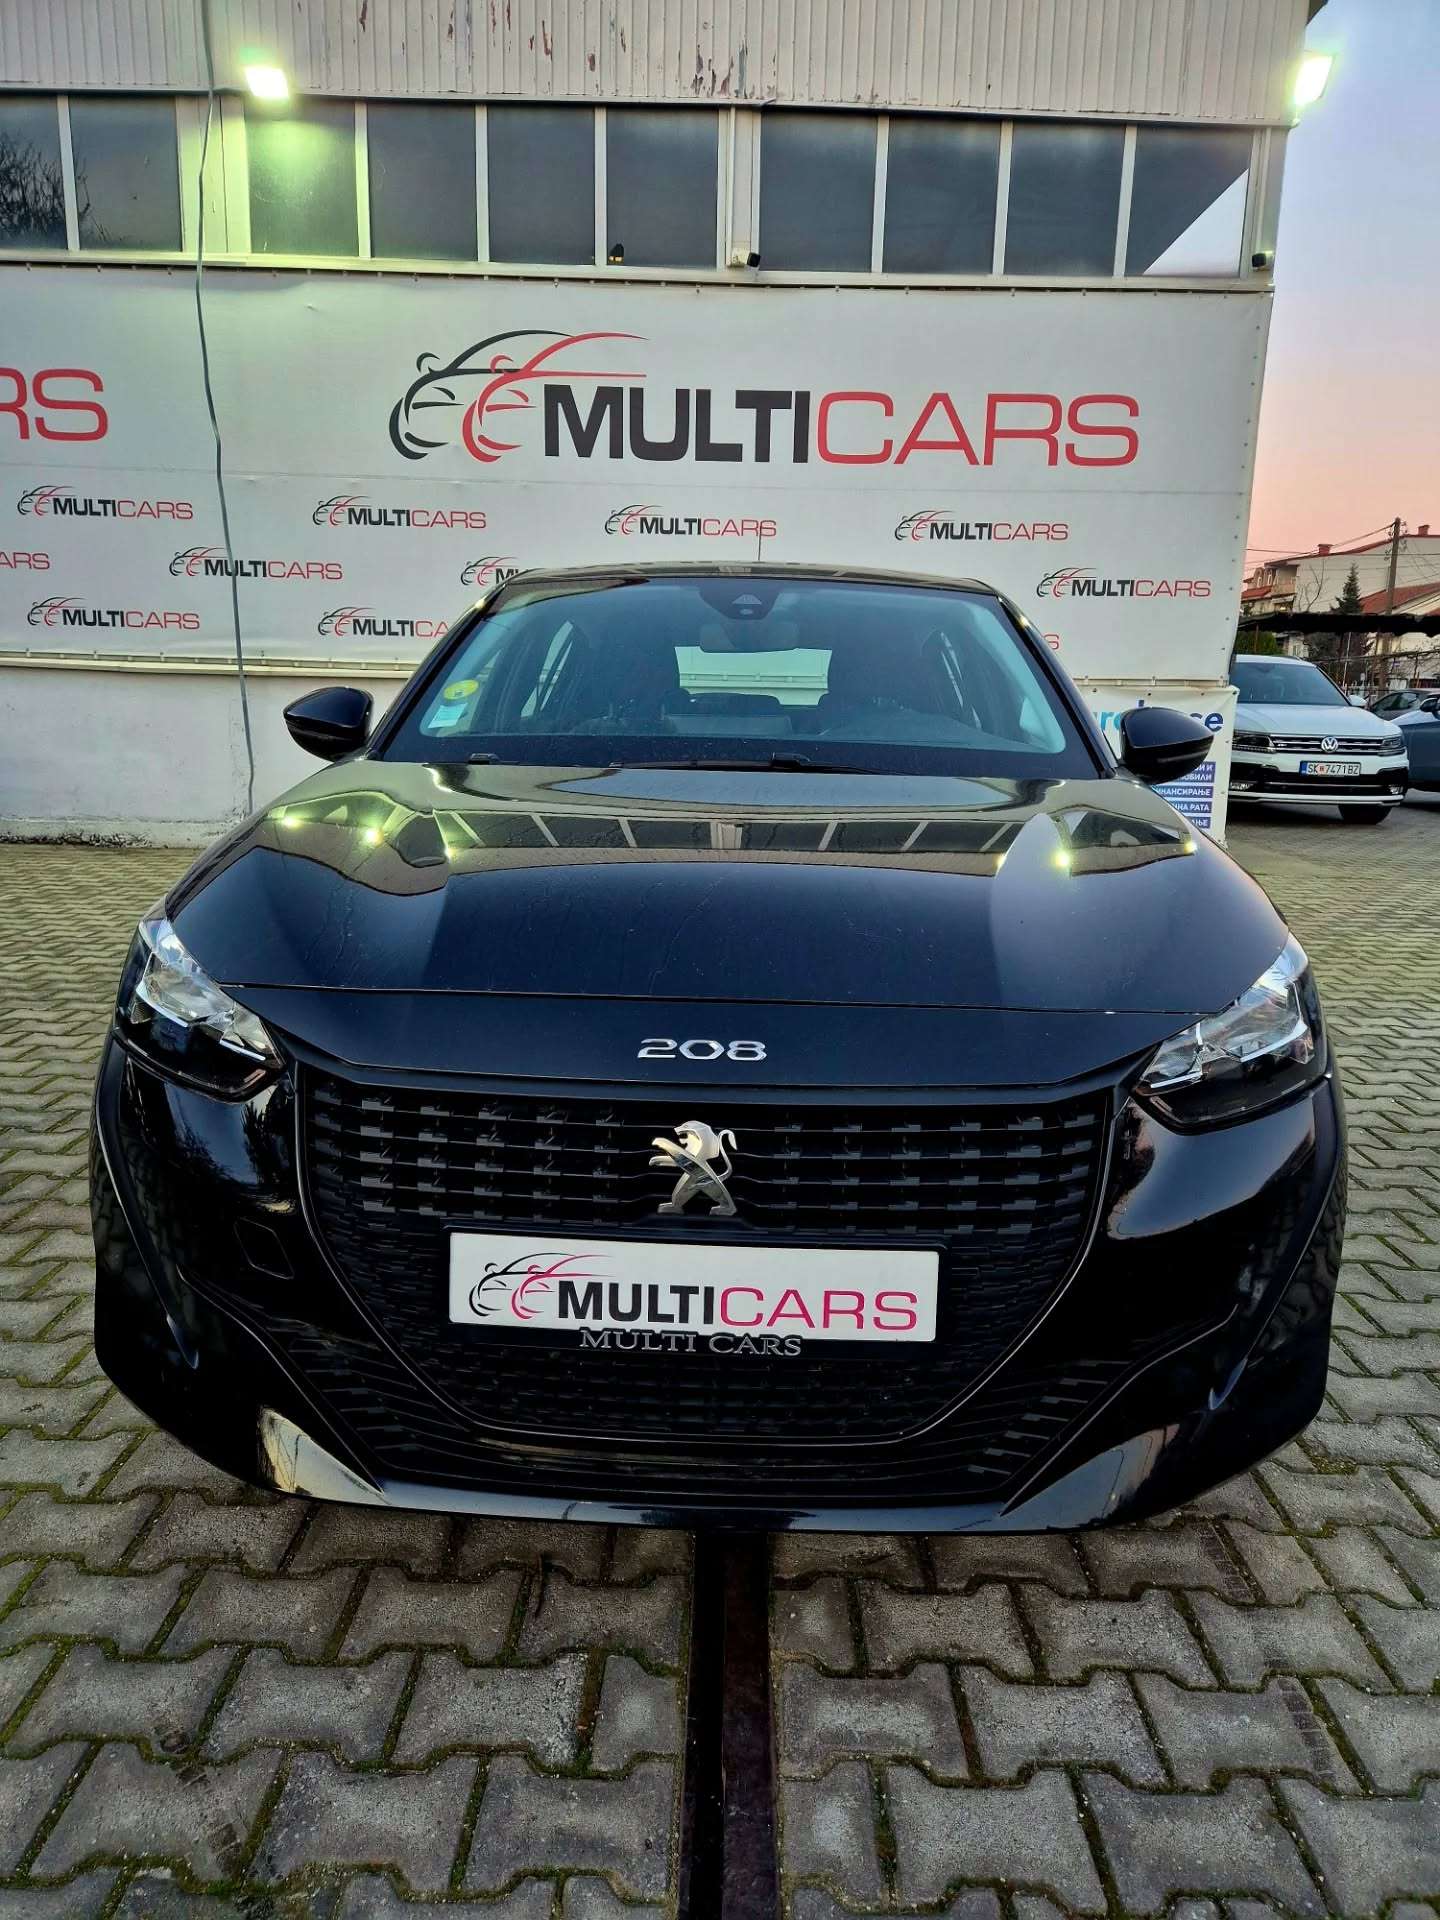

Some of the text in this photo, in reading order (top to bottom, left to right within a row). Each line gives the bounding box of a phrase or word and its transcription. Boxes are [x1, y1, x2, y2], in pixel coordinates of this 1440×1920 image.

[544, 383, 1140, 467] MULTICARS
[53, 497, 194, 520] MULTICARS
[347, 508, 487, 529] MULTICARS
[639, 517, 777, 537] MULTICARS
[929, 522, 1069, 541] MULTICARS
[204, 559, 343, 580] MULTICARS
[1071, 579, 1212, 598] MULTICARS
[62, 609, 200, 630] MULTICARS
[636, 1038, 768, 1062] 208
[557, 1280, 919, 1331] MULTICARS
[579, 1329, 802, 1357] MULTI CARS
